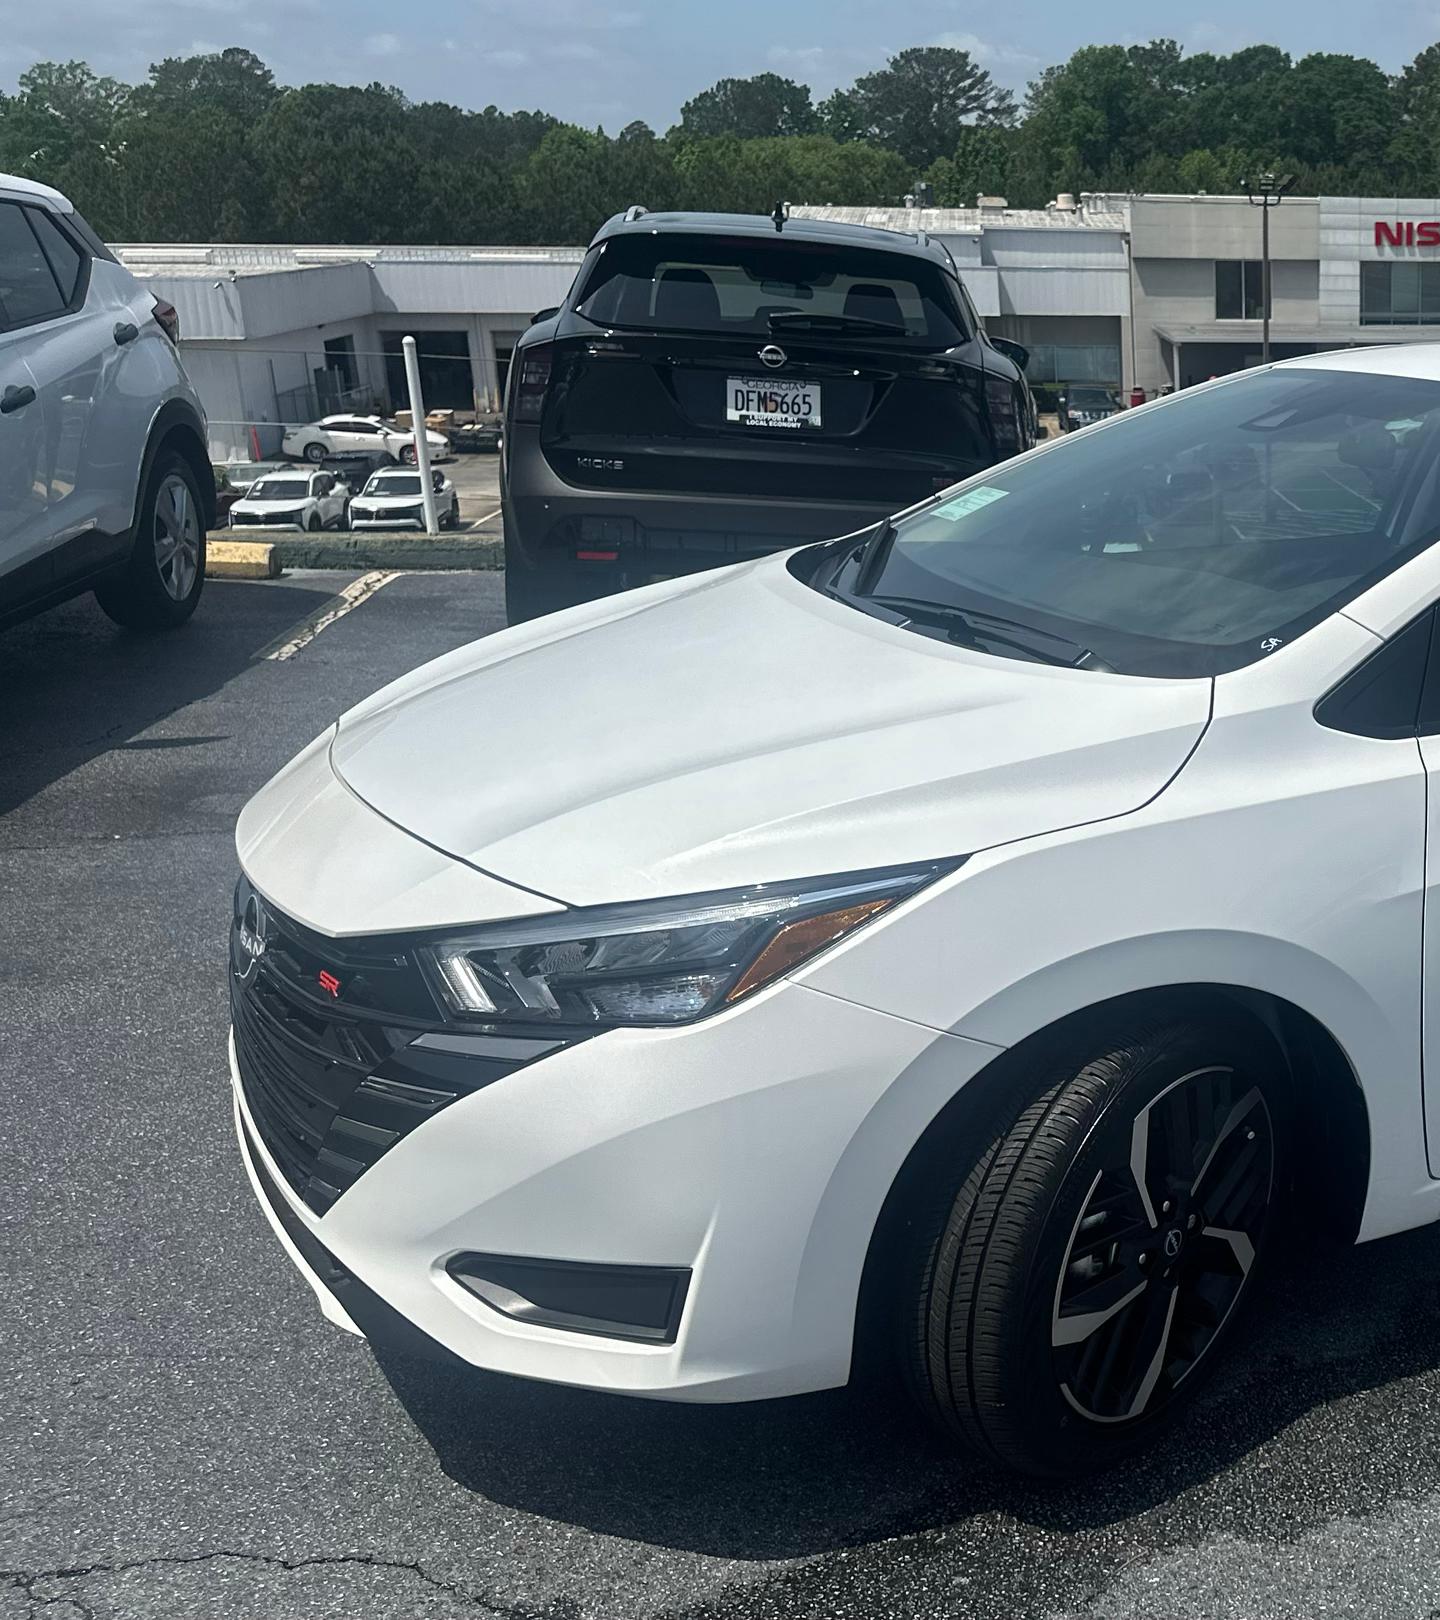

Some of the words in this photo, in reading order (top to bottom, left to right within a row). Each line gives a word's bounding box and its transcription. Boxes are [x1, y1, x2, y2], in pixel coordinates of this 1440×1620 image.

[746, 380, 800, 392] GEORGIA
[735, 389, 812, 416] DFM5665
[577, 457, 624, 469] KICKS
